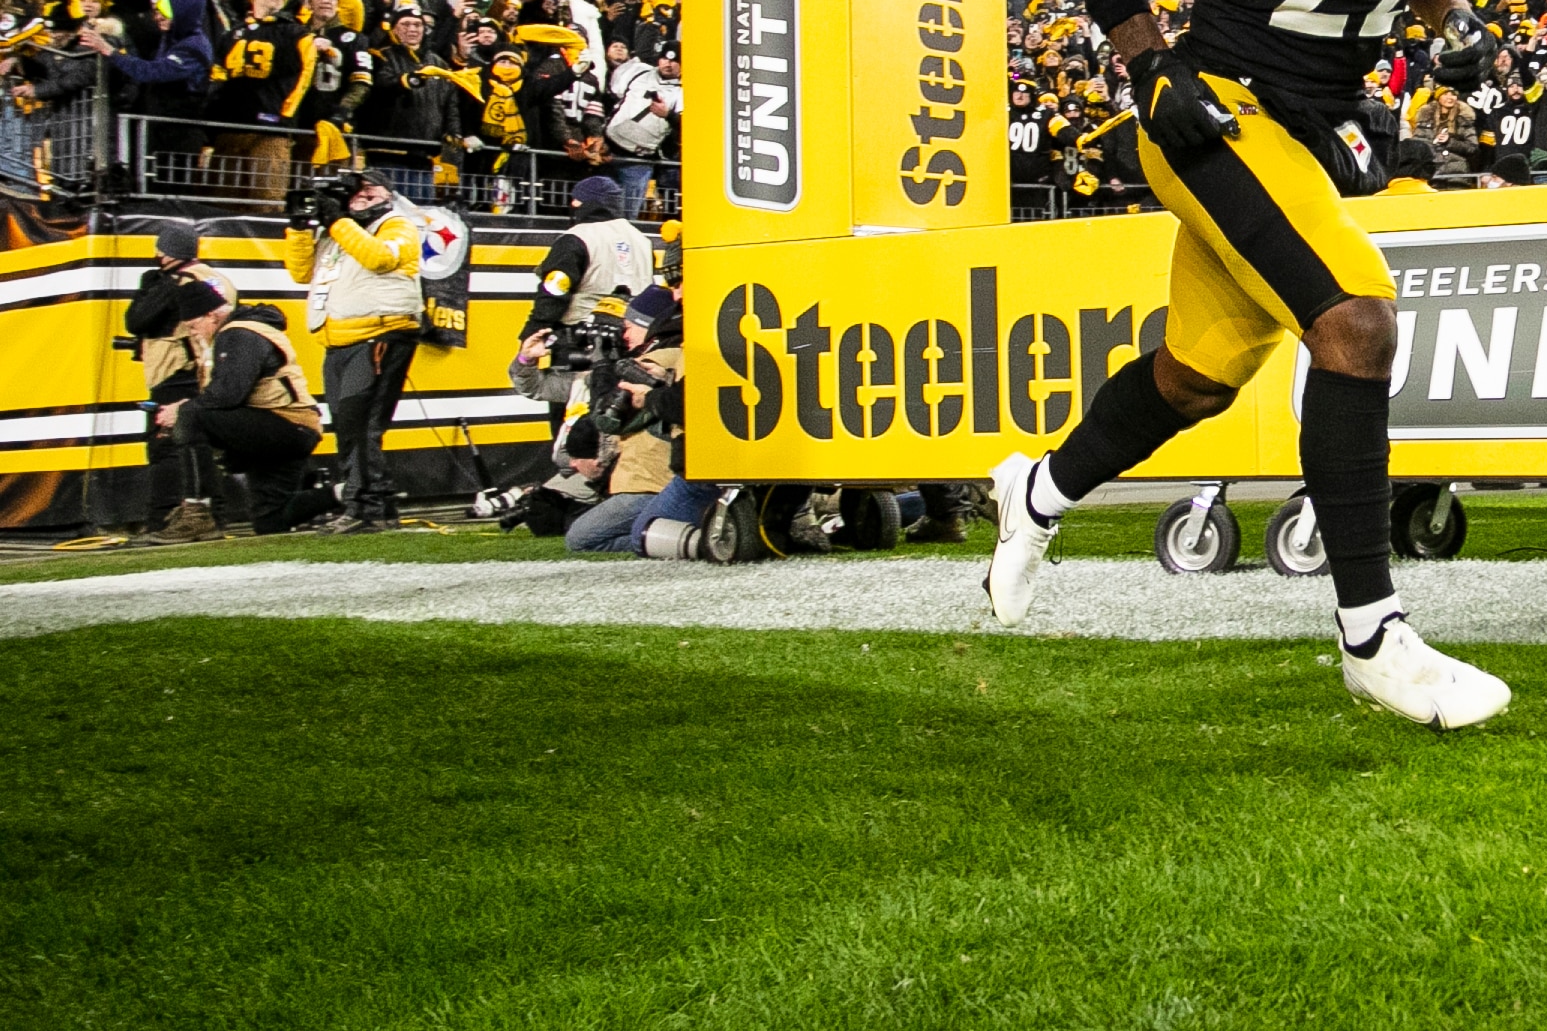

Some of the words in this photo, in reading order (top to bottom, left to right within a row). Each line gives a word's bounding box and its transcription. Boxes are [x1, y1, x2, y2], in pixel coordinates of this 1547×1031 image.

[225, 38, 275, 79] 43
[737, 54, 751, 181] STEELERS
[1009, 121, 1040, 152] 90
[1500, 115, 1532, 146] 90
[717, 267, 1167, 441] Steeler
